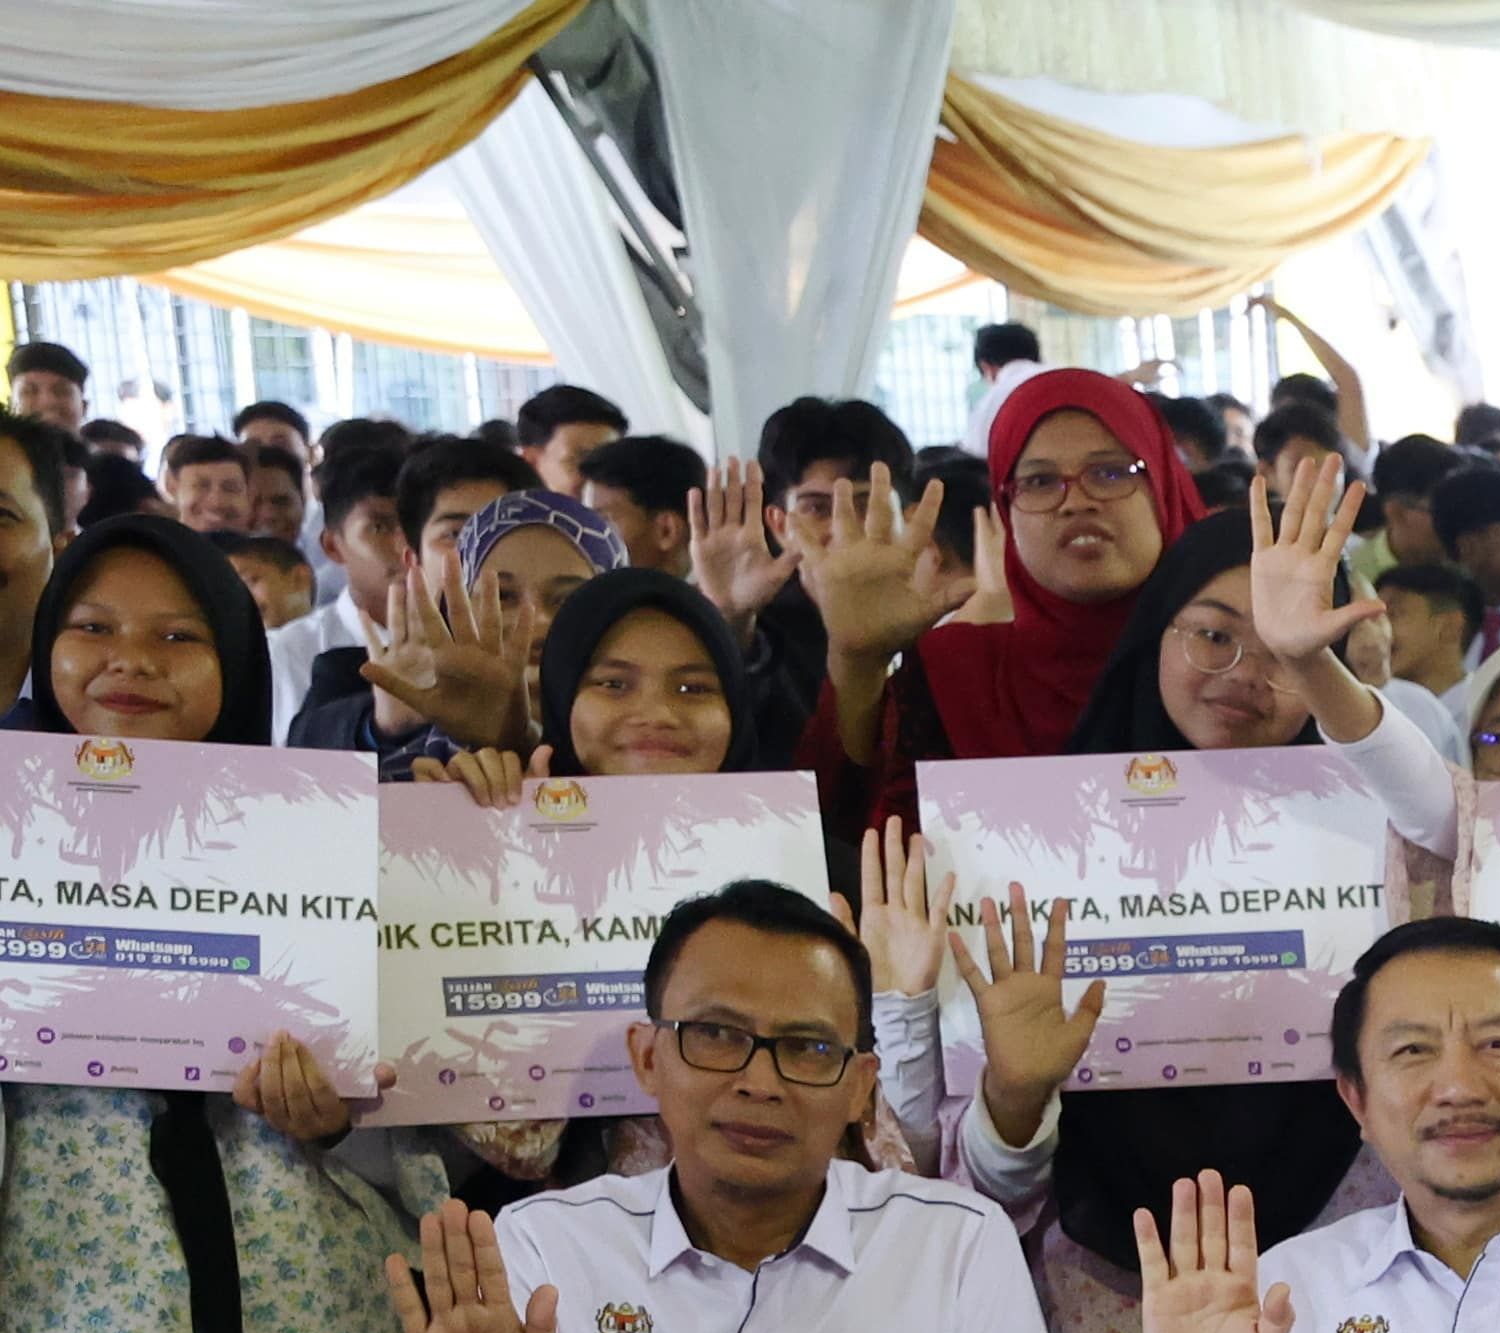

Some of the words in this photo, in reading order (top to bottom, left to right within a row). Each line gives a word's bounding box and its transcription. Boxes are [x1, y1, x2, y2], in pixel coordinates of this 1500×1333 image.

[56, 880, 156, 909] MASA
[170, 887, 287, 916] DEPAN
[1120, 892, 1209, 917] MASA
[1220, 887, 1325, 912] DEPAN
[430, 918, 569, 953] CERITA,
